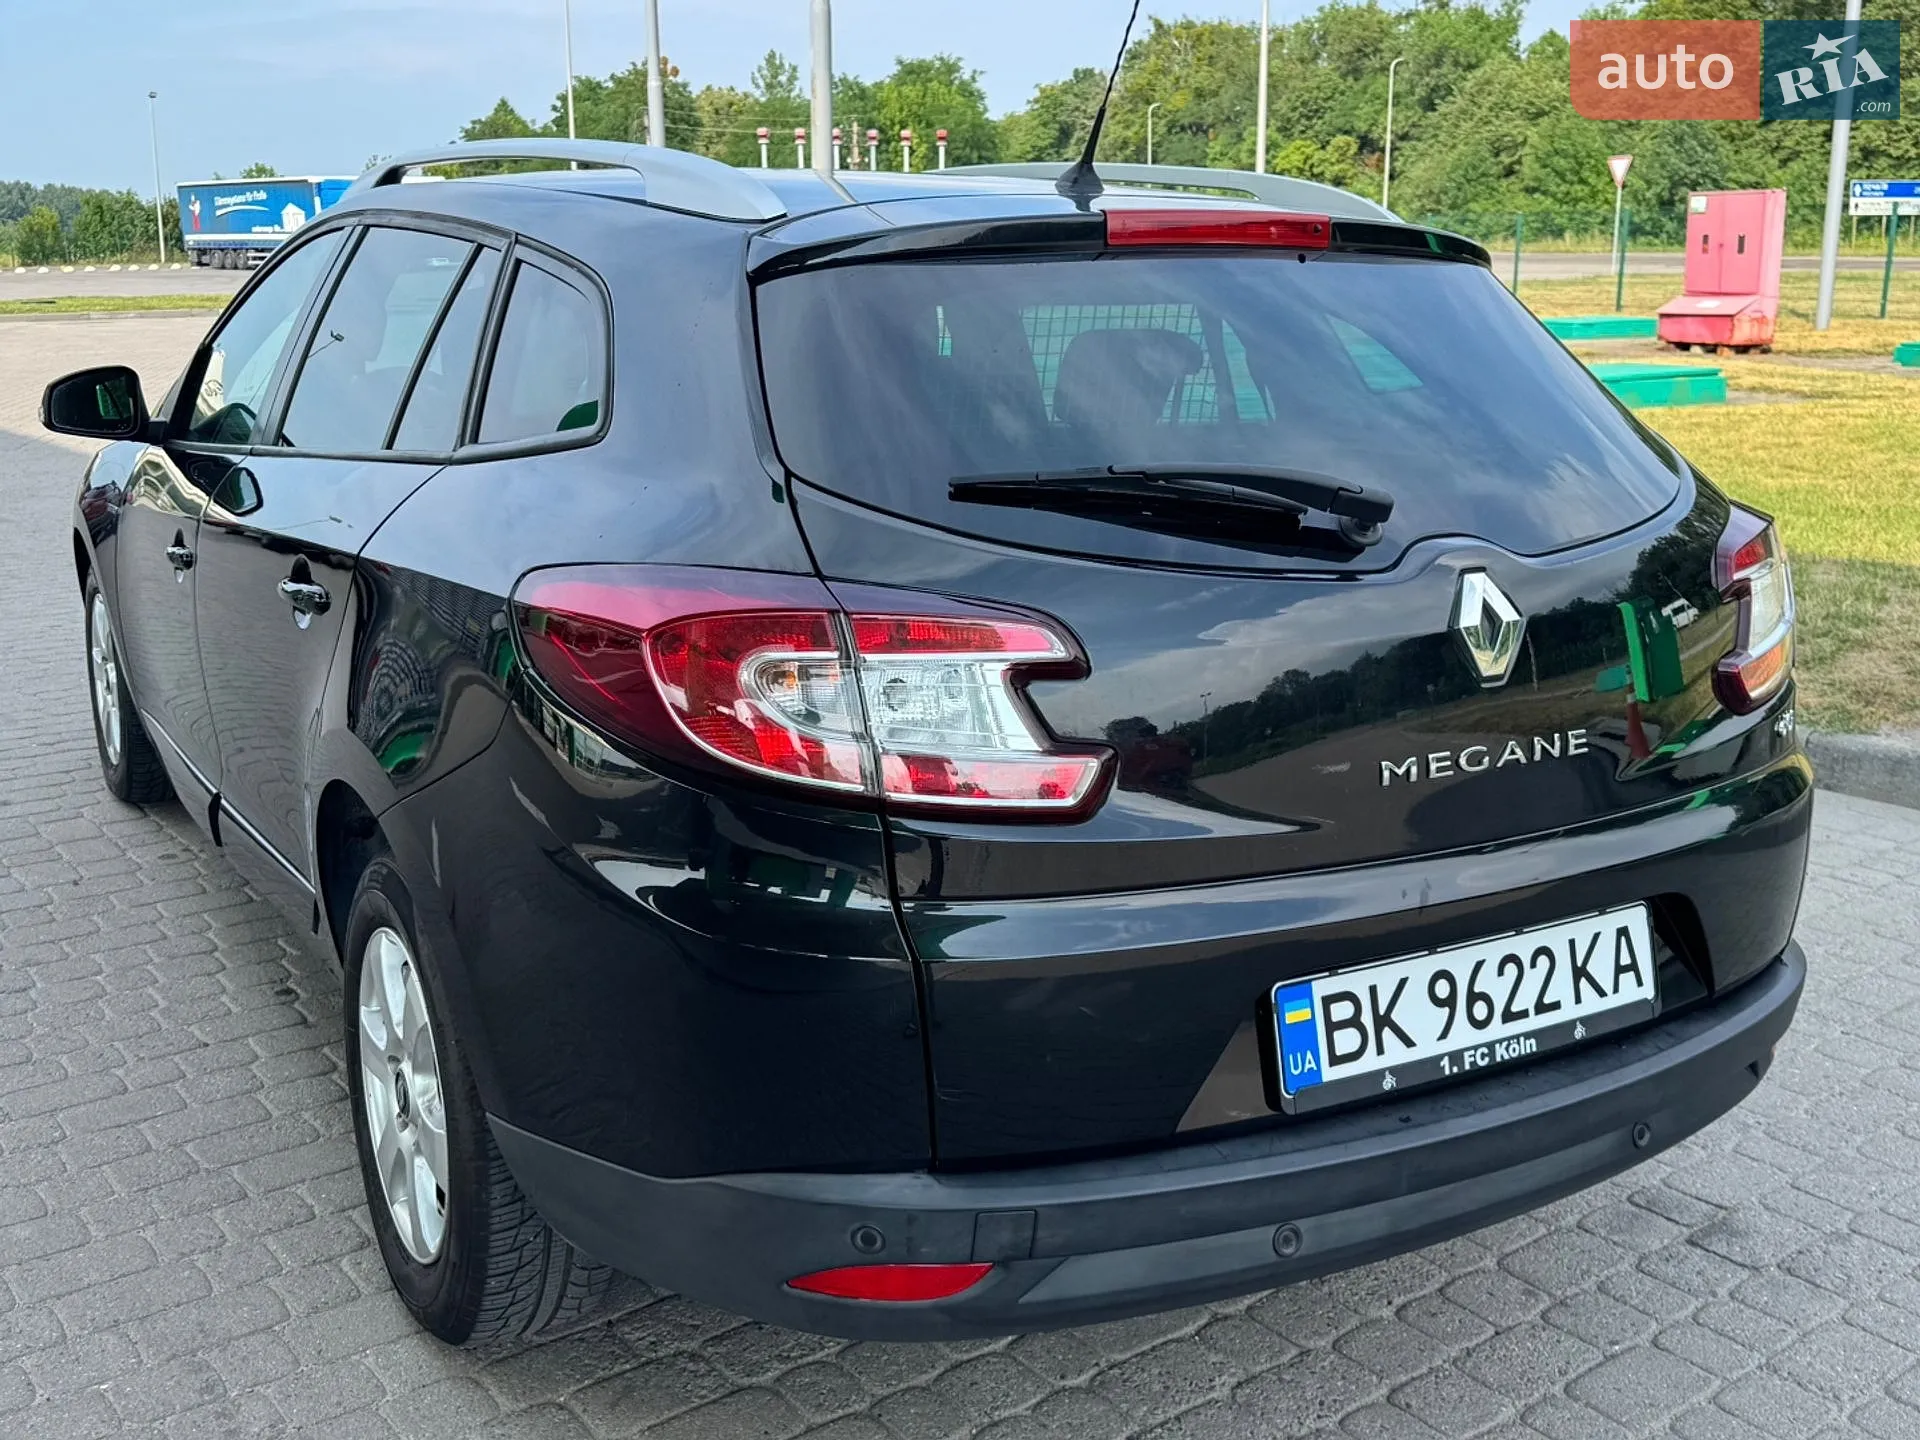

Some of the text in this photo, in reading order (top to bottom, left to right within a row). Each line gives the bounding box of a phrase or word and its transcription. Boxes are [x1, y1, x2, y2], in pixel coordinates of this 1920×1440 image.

[1380, 728, 1590, 787] MEGANE
[1426, 944, 1562, 1042] 9622
[1289, 1050, 1318, 1076] UA
[1440, 1035, 1538, 1076] 1. FC Köln
